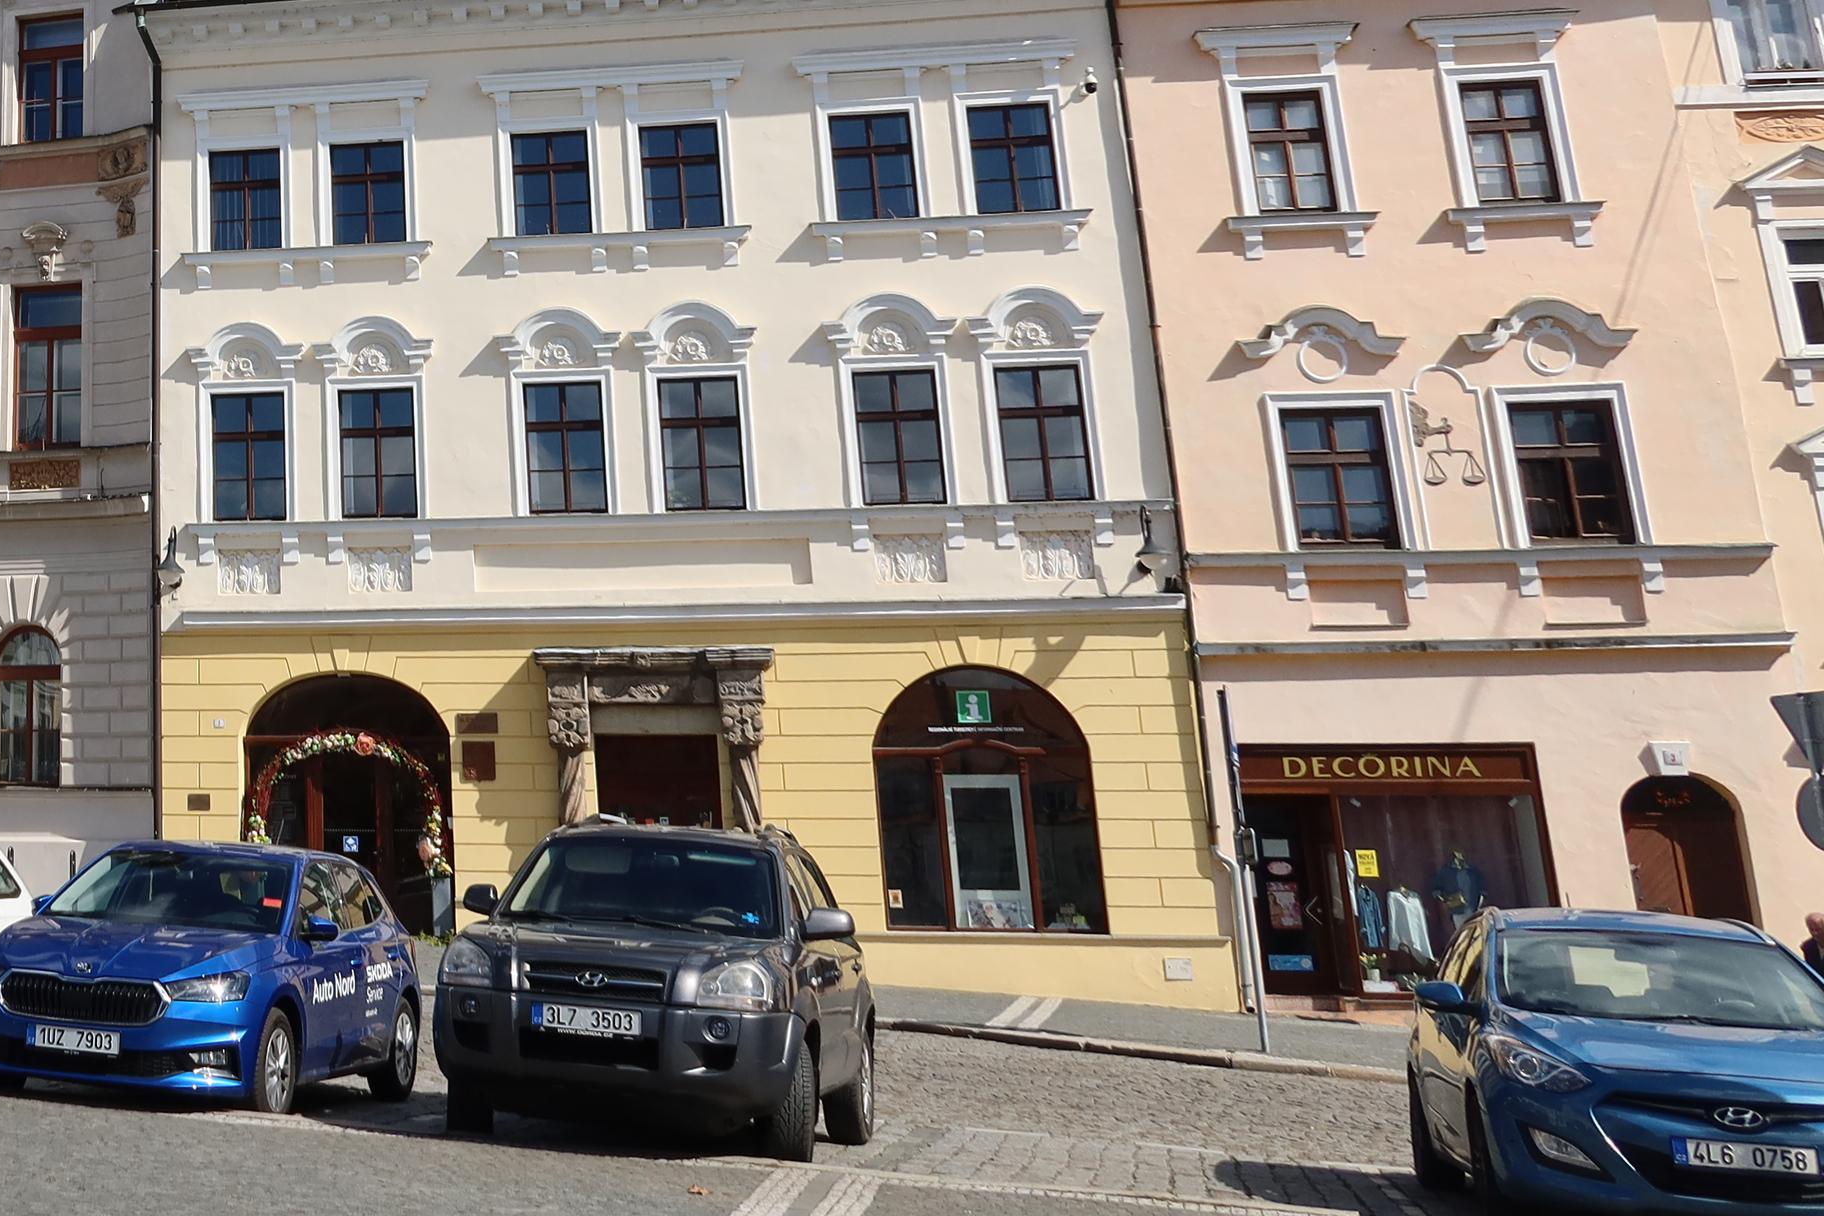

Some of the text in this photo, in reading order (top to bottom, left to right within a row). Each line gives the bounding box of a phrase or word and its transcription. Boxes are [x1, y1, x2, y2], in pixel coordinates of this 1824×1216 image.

[1282, 756, 1482, 778] DECORINA
[312, 969, 356, 1005] Auto Nord
[366, 984, 384, 1004] Service
[546, 1006, 577, 1026] 3L7
[591, 1010, 634, 1031] 3503
[39, 1027, 113, 1050] 1UZ 7903
[1693, 1142, 1734, 1165] 4L6
[1753, 1147, 1807, 1171] 0758
